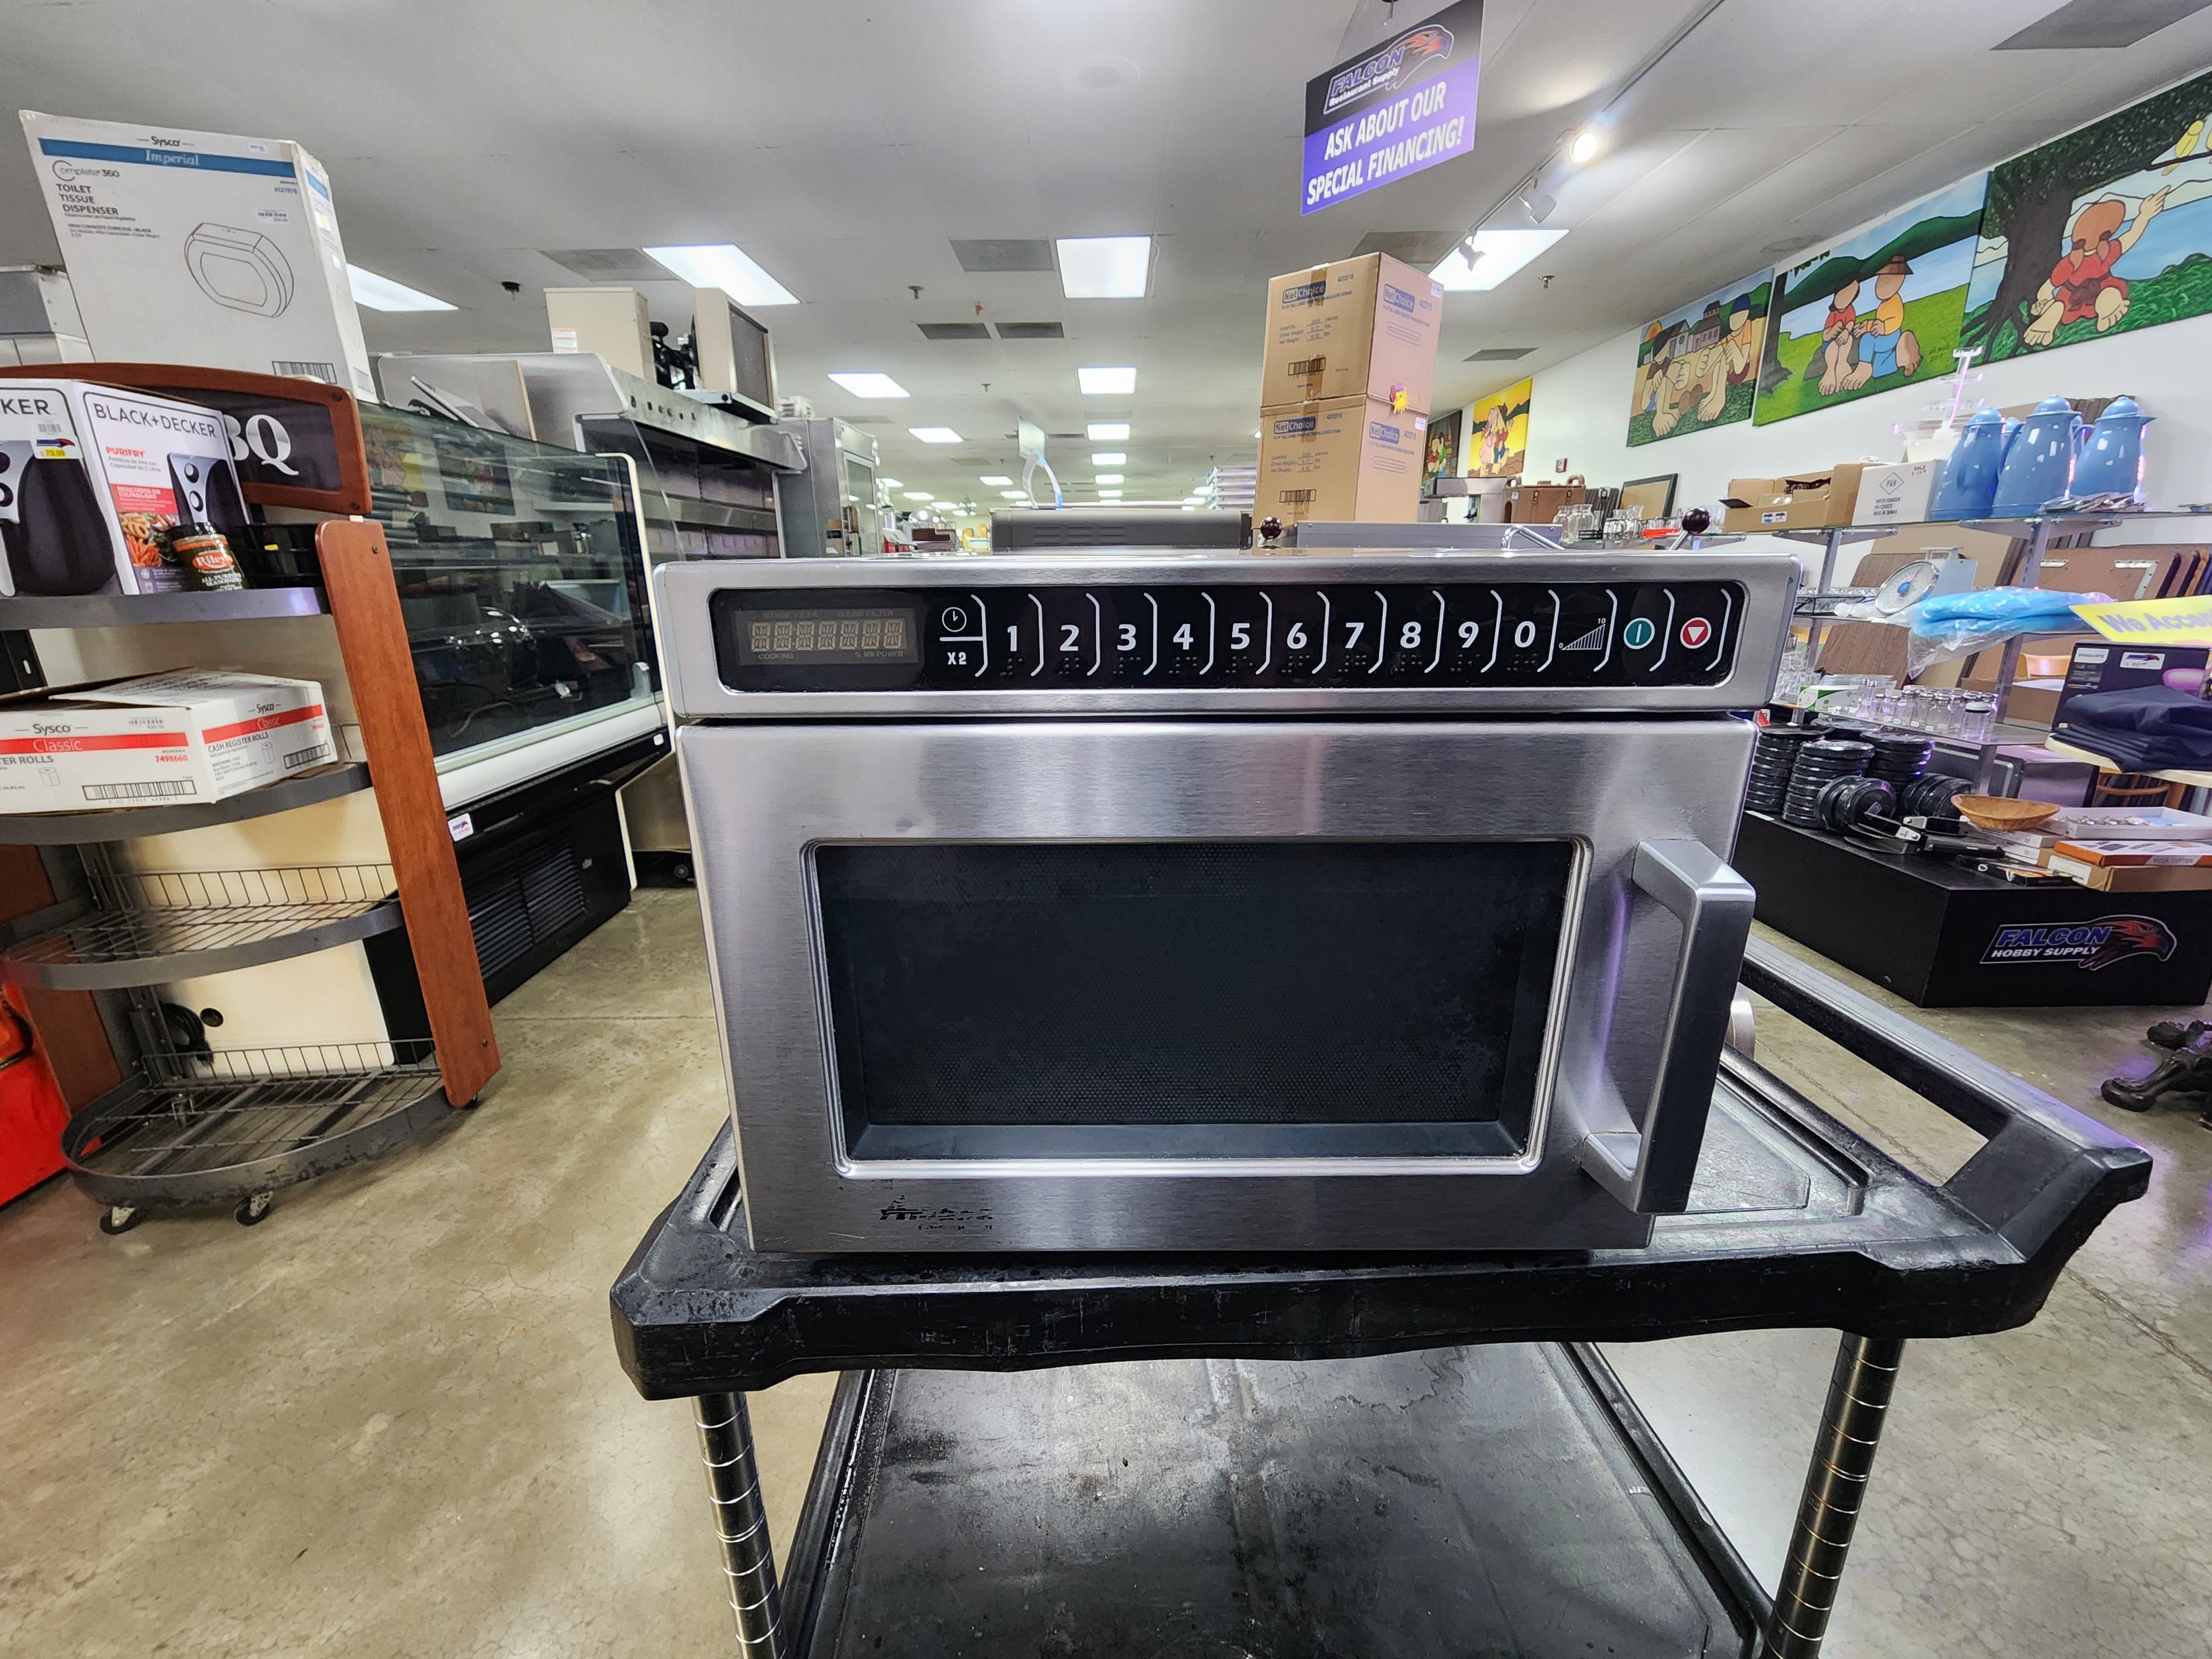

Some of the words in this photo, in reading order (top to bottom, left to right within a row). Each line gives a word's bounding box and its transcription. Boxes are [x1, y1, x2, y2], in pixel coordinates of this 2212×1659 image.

[1331, 45, 1406, 97] FALCON
[1329, 79, 1371, 107] Restaurant
[1372, 66, 1400, 85] Supply
[1324, 122, 1355, 160] ASK
[1355, 97, 1410, 147] ABOUT
[1411, 81, 1447, 122] OUR
[151, 135, 181, 147] Sysco
[145, 150, 199, 166] Imperial
[1307, 158, 1364, 206] SPECIAL
[1367, 115, 1465, 181] FINANCING!
[101, 169, 120, 178] 360
[56, 184, 91, 194] TOILET
[59, 193, 96, 204] TISSUE
[62, 204, 119, 216] DISPENSER
[1284, 285, 1324, 301] NetChoice
[1384, 287, 1413, 310] NetChoice
[0, 398, 52, 415] KER
[93, 403, 217, 439] BLACK+DECKER
[1275, 420, 1314, 432] NetChoice
[1370, 424, 1399, 441] NetChoice
[106, 446, 145, 458] PURIFRY
[2096, 614, 2147, 633] We
[1007, 625, 1017, 651] 1
[1060, 624, 1079, 651] 2
[1117, 624, 1136, 651] 3
[1173, 623, 1193, 650] 4
[1230, 623, 1250, 649] 5
[1287, 623, 1307, 649] 6
[1345, 622, 1364, 649] 7
[1400, 622, 1421, 649] 8
[1458, 621, 1479, 648] 9
[1515, 621, 1536, 648] 0
[875, 650, 904, 658] POWER
[947, 651, 967, 665] X2
[256, 703, 275, 714] Sysco
[33, 723, 71, 736] Sysco
[33, 739, 83, 753] Classic
[208, 743, 225, 753] CASH
[225, 736, 252, 749] REGISTER
[252, 731, 269, 742] ROLLS
[19, 755, 54, 764] ROLLS
[154, 755, 189, 763] 7498660
[1995, 926, 2112, 947] FALCON
[1991, 948, 2041, 958] HOBBY
[2043, 946, 2100, 957] SUPPLY
